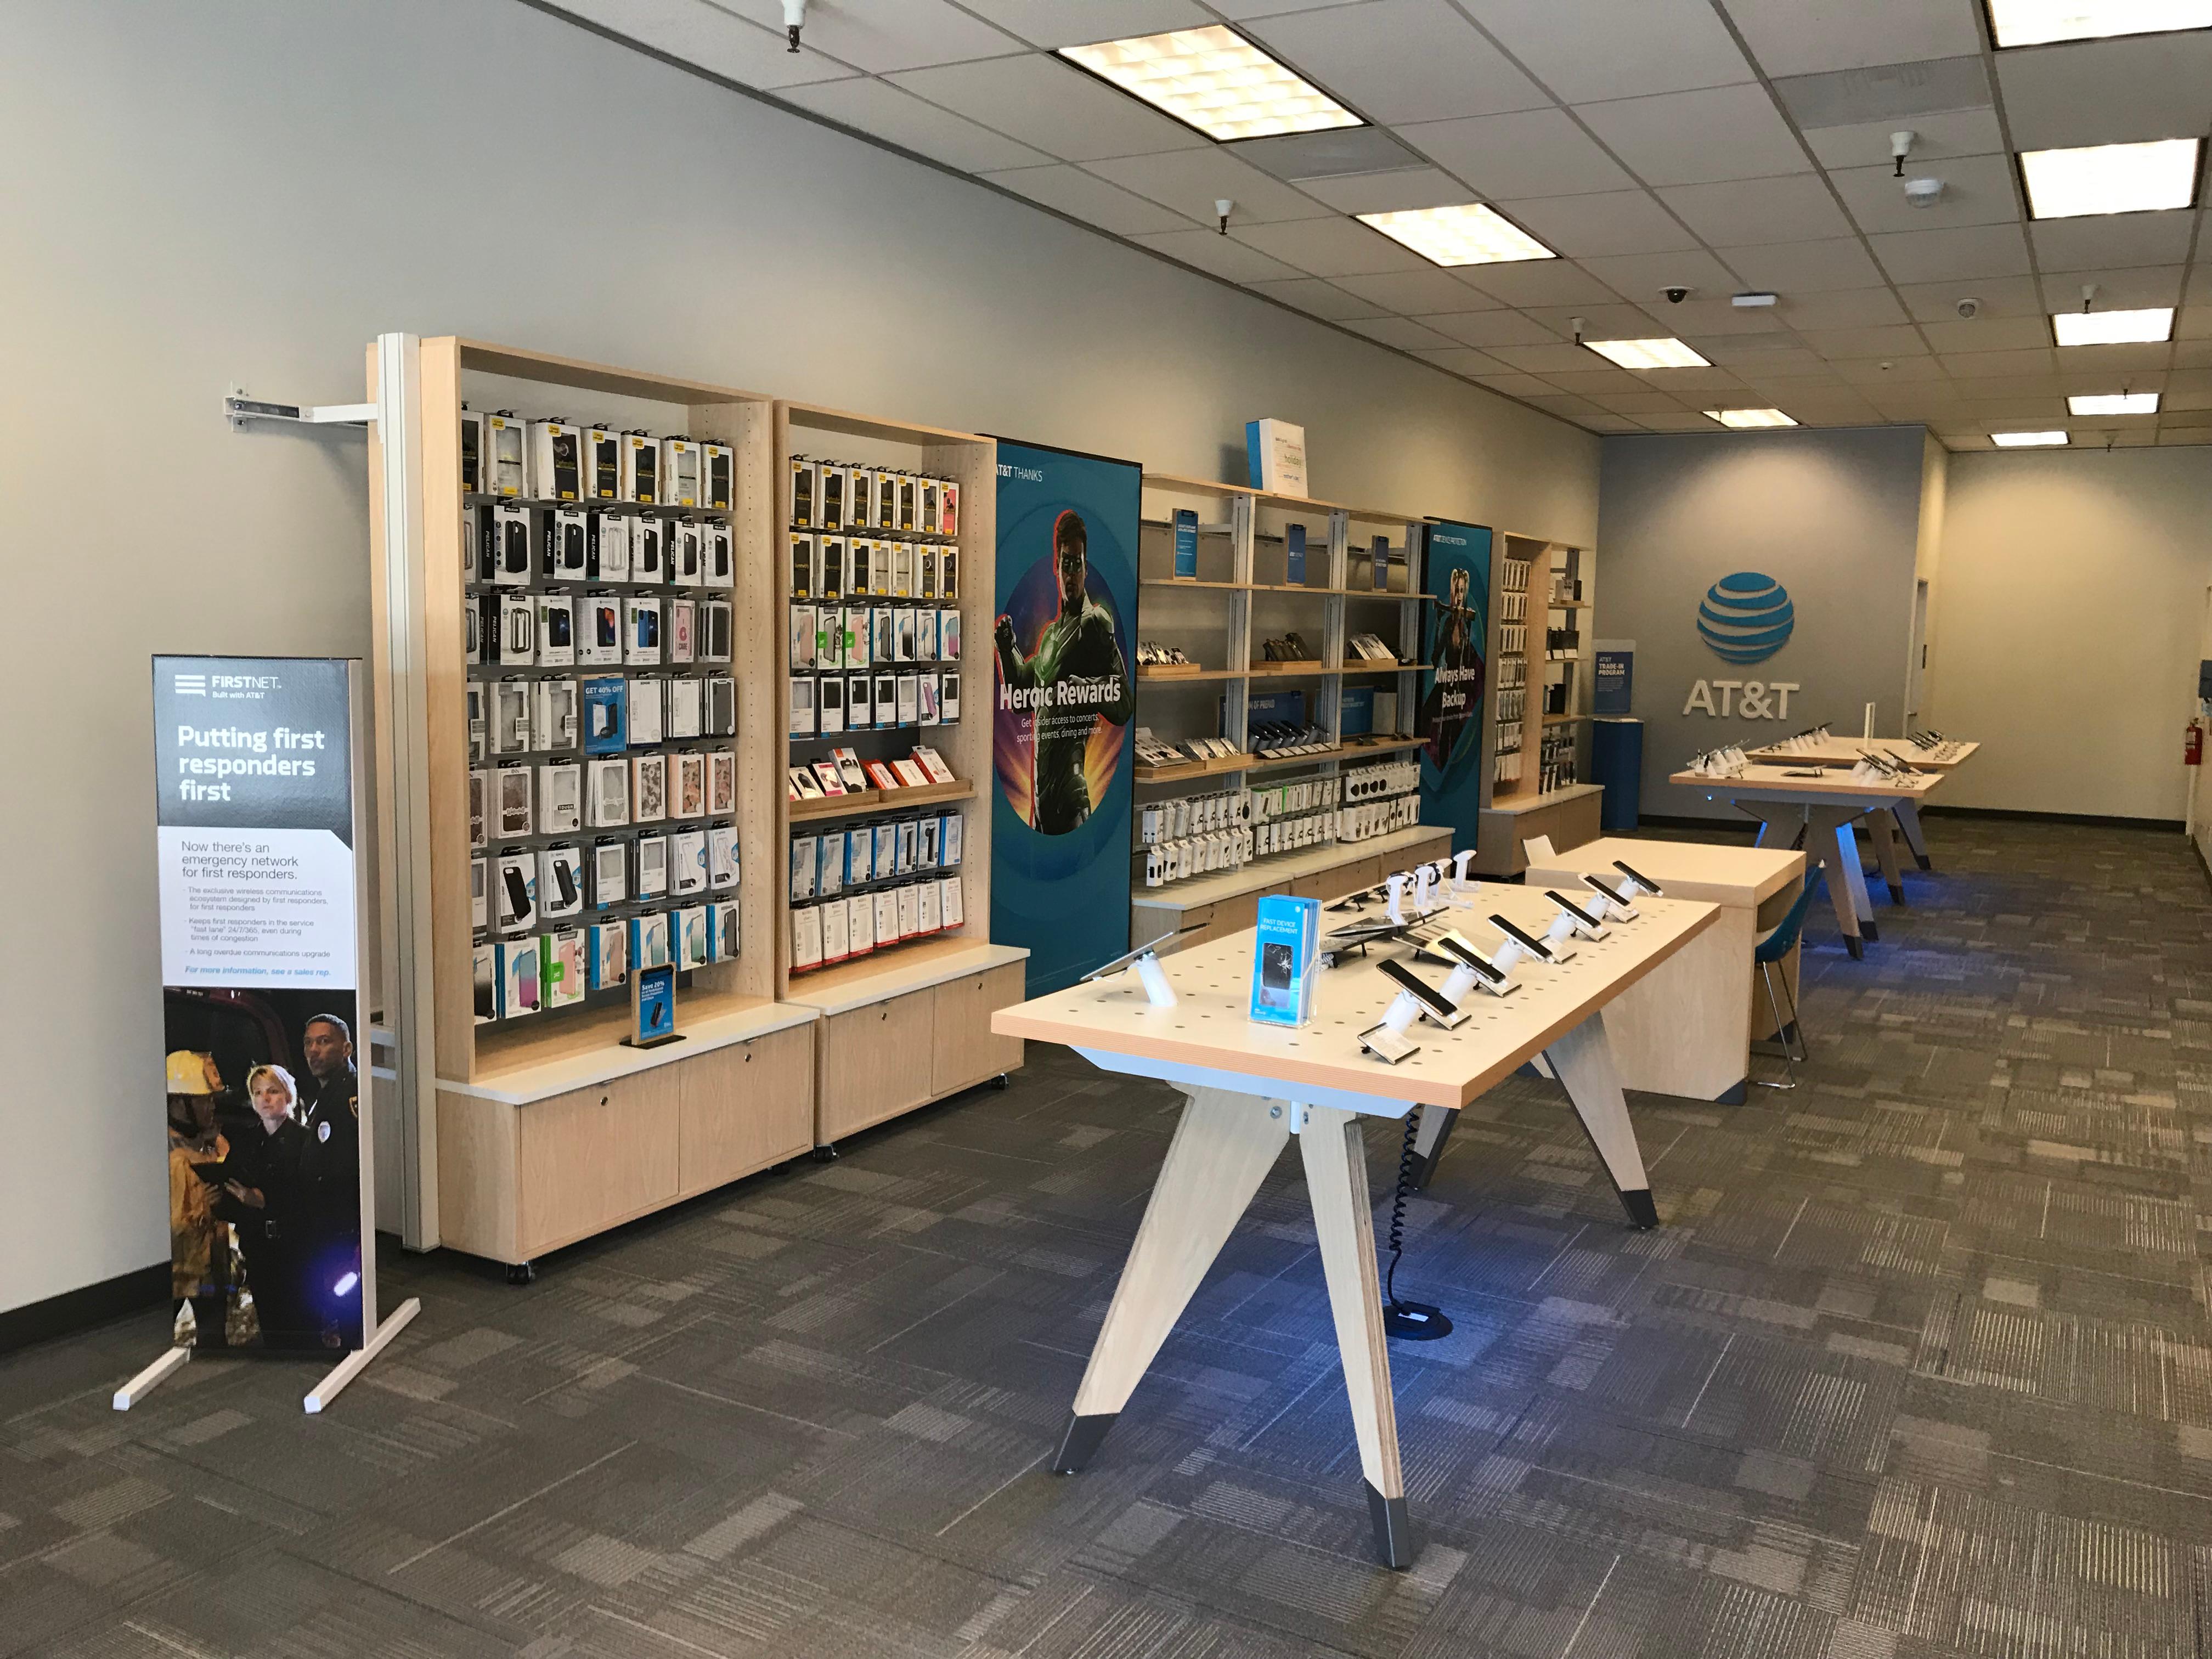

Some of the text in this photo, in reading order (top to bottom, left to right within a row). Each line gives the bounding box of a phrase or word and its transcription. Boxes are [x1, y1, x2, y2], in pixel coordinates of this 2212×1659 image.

[1013, 466, 1042, 482] THANKS
[212, 675, 279, 689] FIRSTNET
[1435, 665, 1475, 687] Always Have
[598, 686, 611, 694] 40%
[1000, 676, 1121, 710] Heroic Rewards
[1442, 690, 1466, 709] Backup
[1682, 680, 1800, 720] AT&T
[1021, 718, 1032, 728] Get
[1052, 716, 1069, 725] access
[1069, 715, 1076, 723] to
[178, 725, 325, 753] Putting first
[1017, 732, 1040, 744] sportig
[1061, 727, 1077, 739] dining
[1077, 726, 1087, 736] and
[179, 754, 315, 778] responders
[179, 780, 231, 802] first
[182, 841, 270, 853] Now there's an
[182, 856, 298, 868] emergency network
[182, 866, 297, 881] for first responders.
[262, 896, 270, 905] by
[228, 918, 267, 927] responders
[1260, 924, 1298, 934] REPLACEMENT
[1277, 919, 1296, 928] DEVICE
[280, 927, 302, 936] during
[197, 948, 212, 956] long
[302, 950, 330, 958] upgrade
[222, 967, 269, 975] information,
